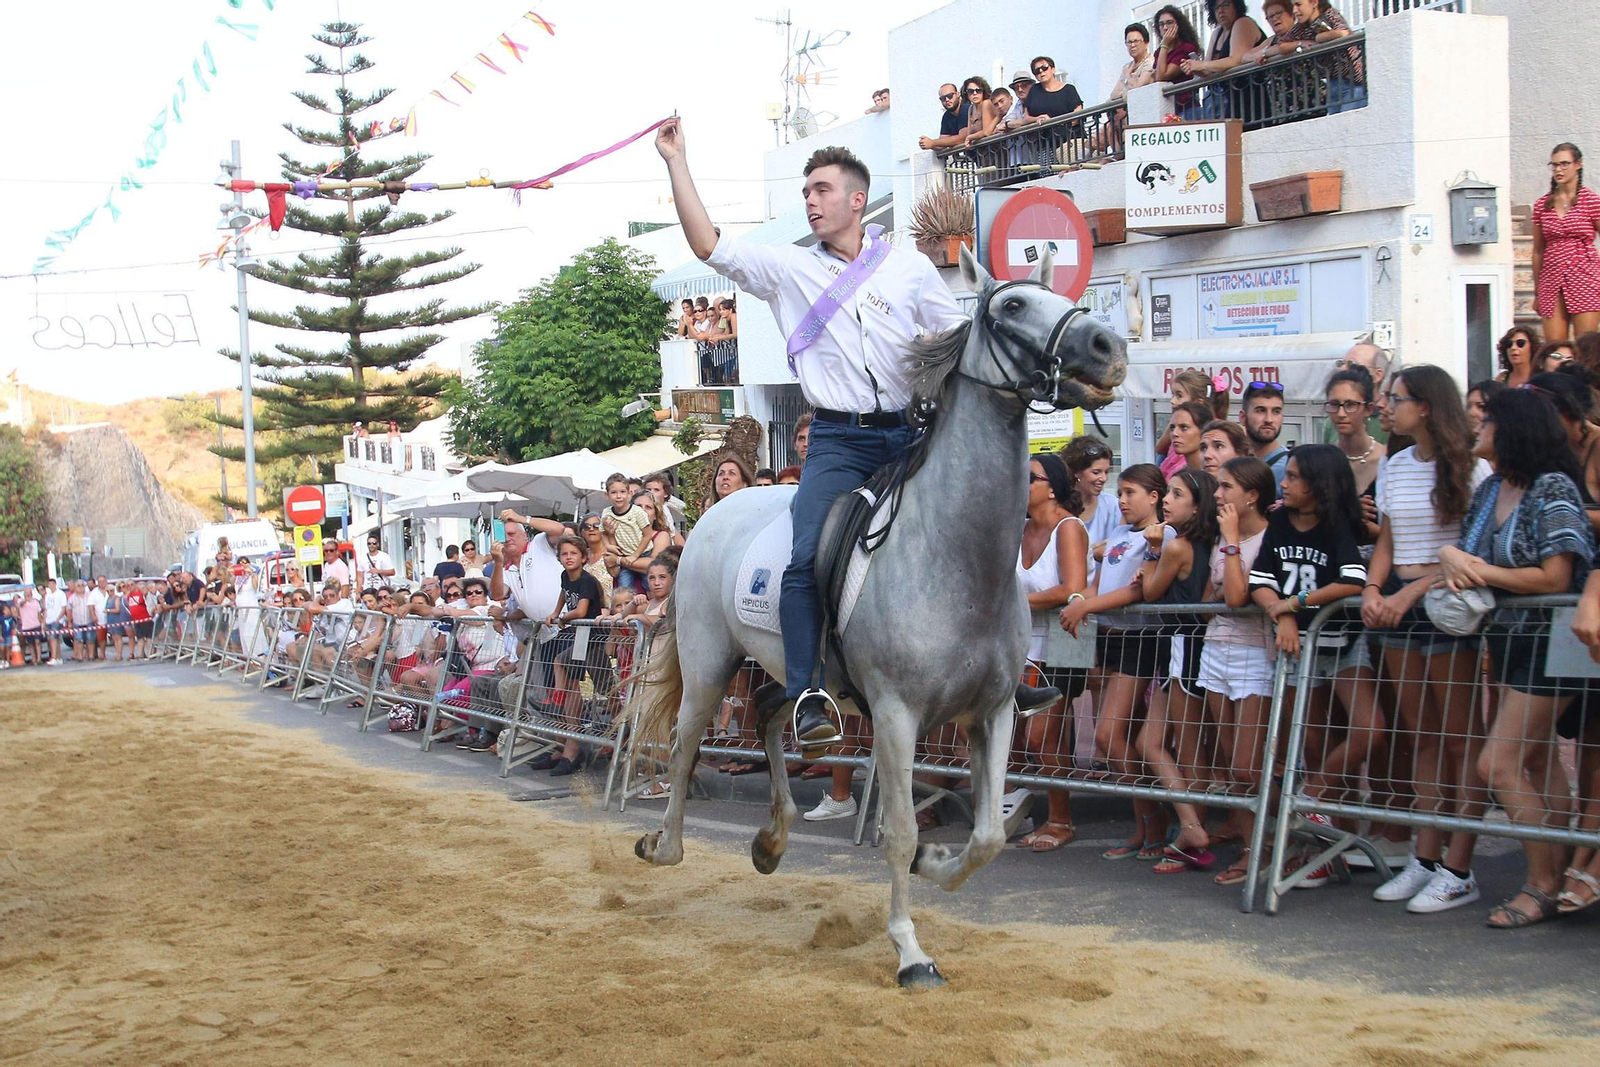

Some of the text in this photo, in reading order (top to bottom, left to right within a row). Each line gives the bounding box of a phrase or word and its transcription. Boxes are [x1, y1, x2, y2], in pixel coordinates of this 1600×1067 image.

[1131, 128, 1220, 147] REGALOS TITI
[1127, 203, 1225, 218] COMPLEMENTOS
[1414, 225, 1429, 237] 24
[829, 276, 858, 303] Flores
[1227, 304, 1290, 317] DETECCIÓN DE FUGAS
[1249, 366, 1280, 383] TITI
[1134, 426, 1142, 436] 26
[210, 539, 268, 552] AULANCIA
[1274, 546, 1328, 566] OREVER
[1282, 561, 1317, 596] 78
